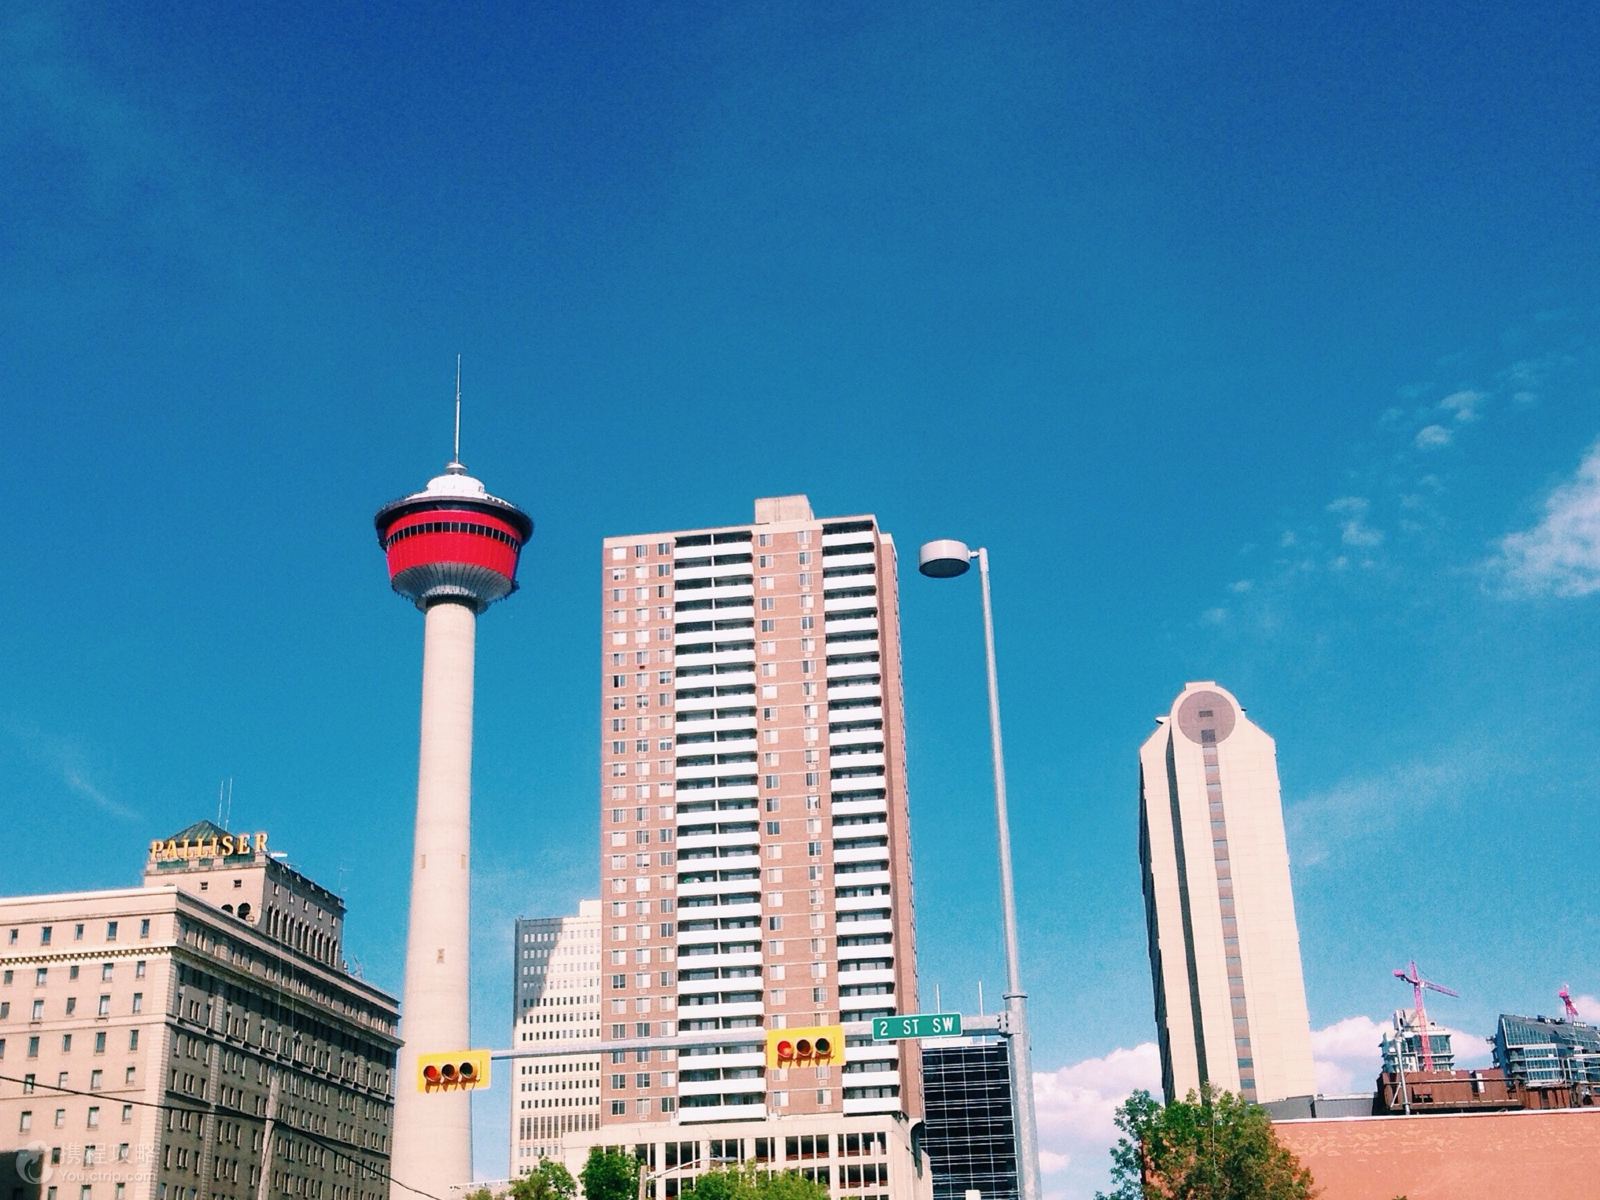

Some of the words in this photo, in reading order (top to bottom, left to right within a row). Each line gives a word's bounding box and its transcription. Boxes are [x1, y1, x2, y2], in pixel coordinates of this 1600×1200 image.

[151, 832, 268, 861] PALLISER
[880, 1021, 888, 1036] 2
[903, 1019, 919, 1035] ST
[932, 1017, 953, 1033] SW
